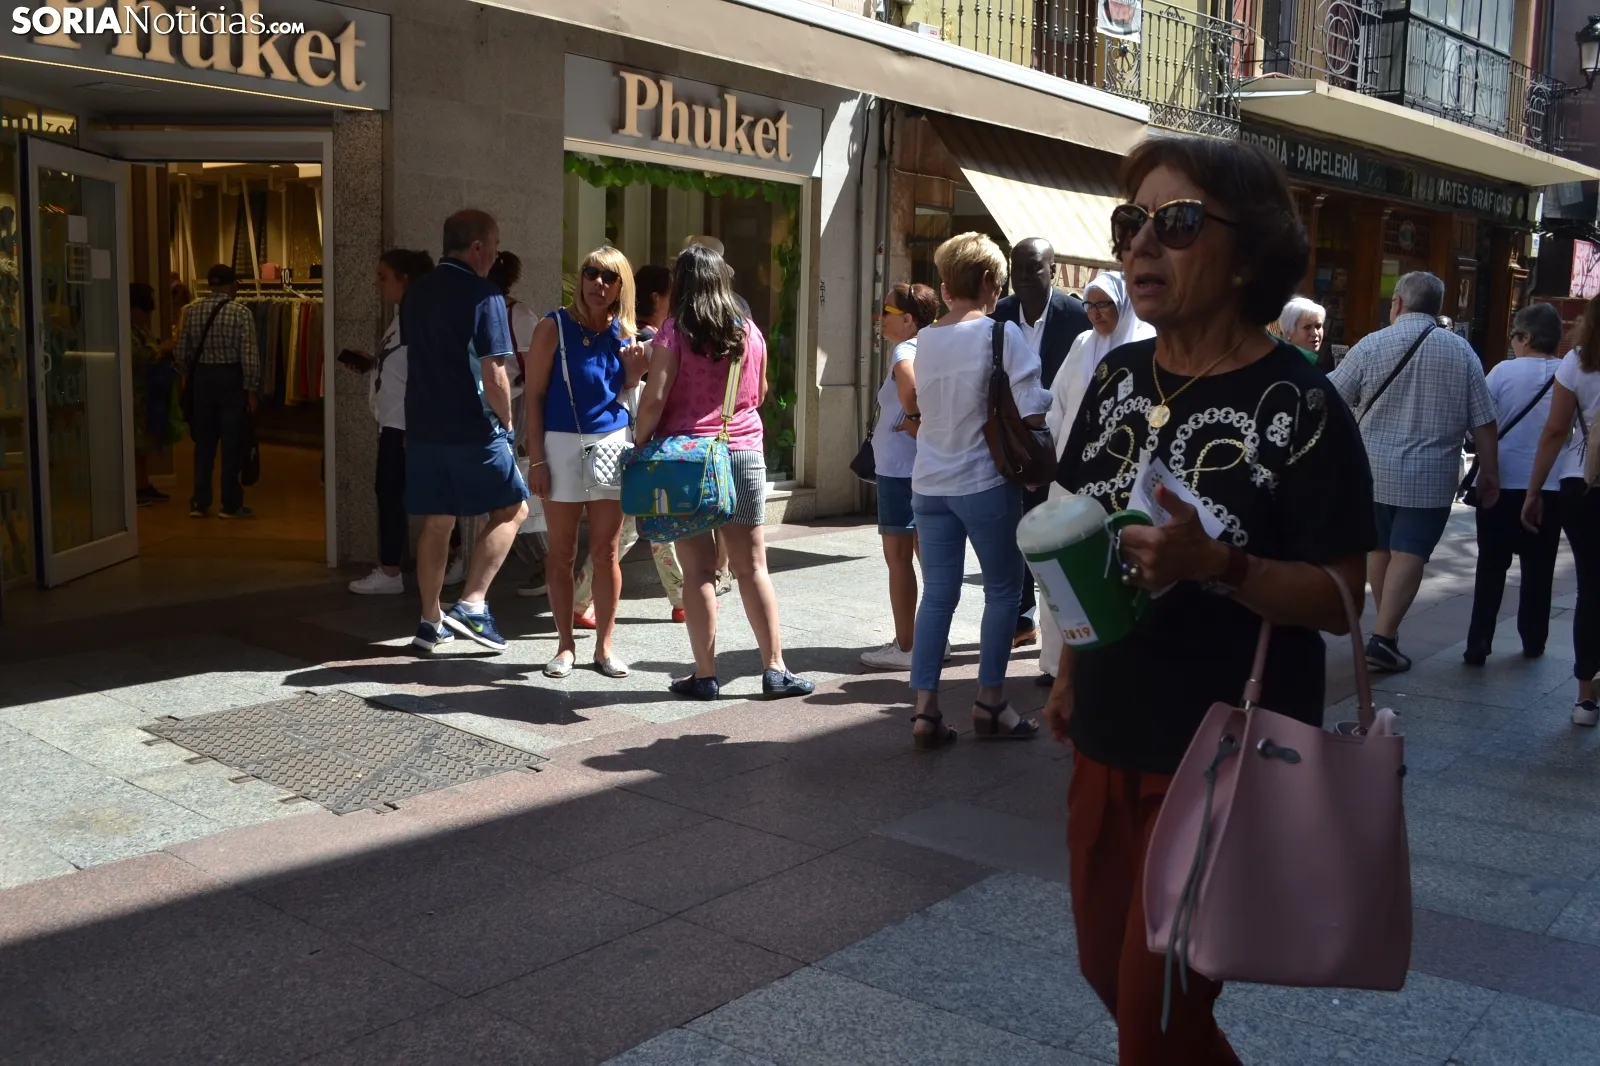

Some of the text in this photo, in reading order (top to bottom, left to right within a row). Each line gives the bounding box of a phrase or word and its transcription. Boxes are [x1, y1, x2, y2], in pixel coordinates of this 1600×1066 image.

[617, 70, 794, 163] Phuket
[1297, 143, 1359, 181] PAPELERÍA
[1438, 178, 1469, 206] ARTES
[1063, 626, 1091, 640] 2019
